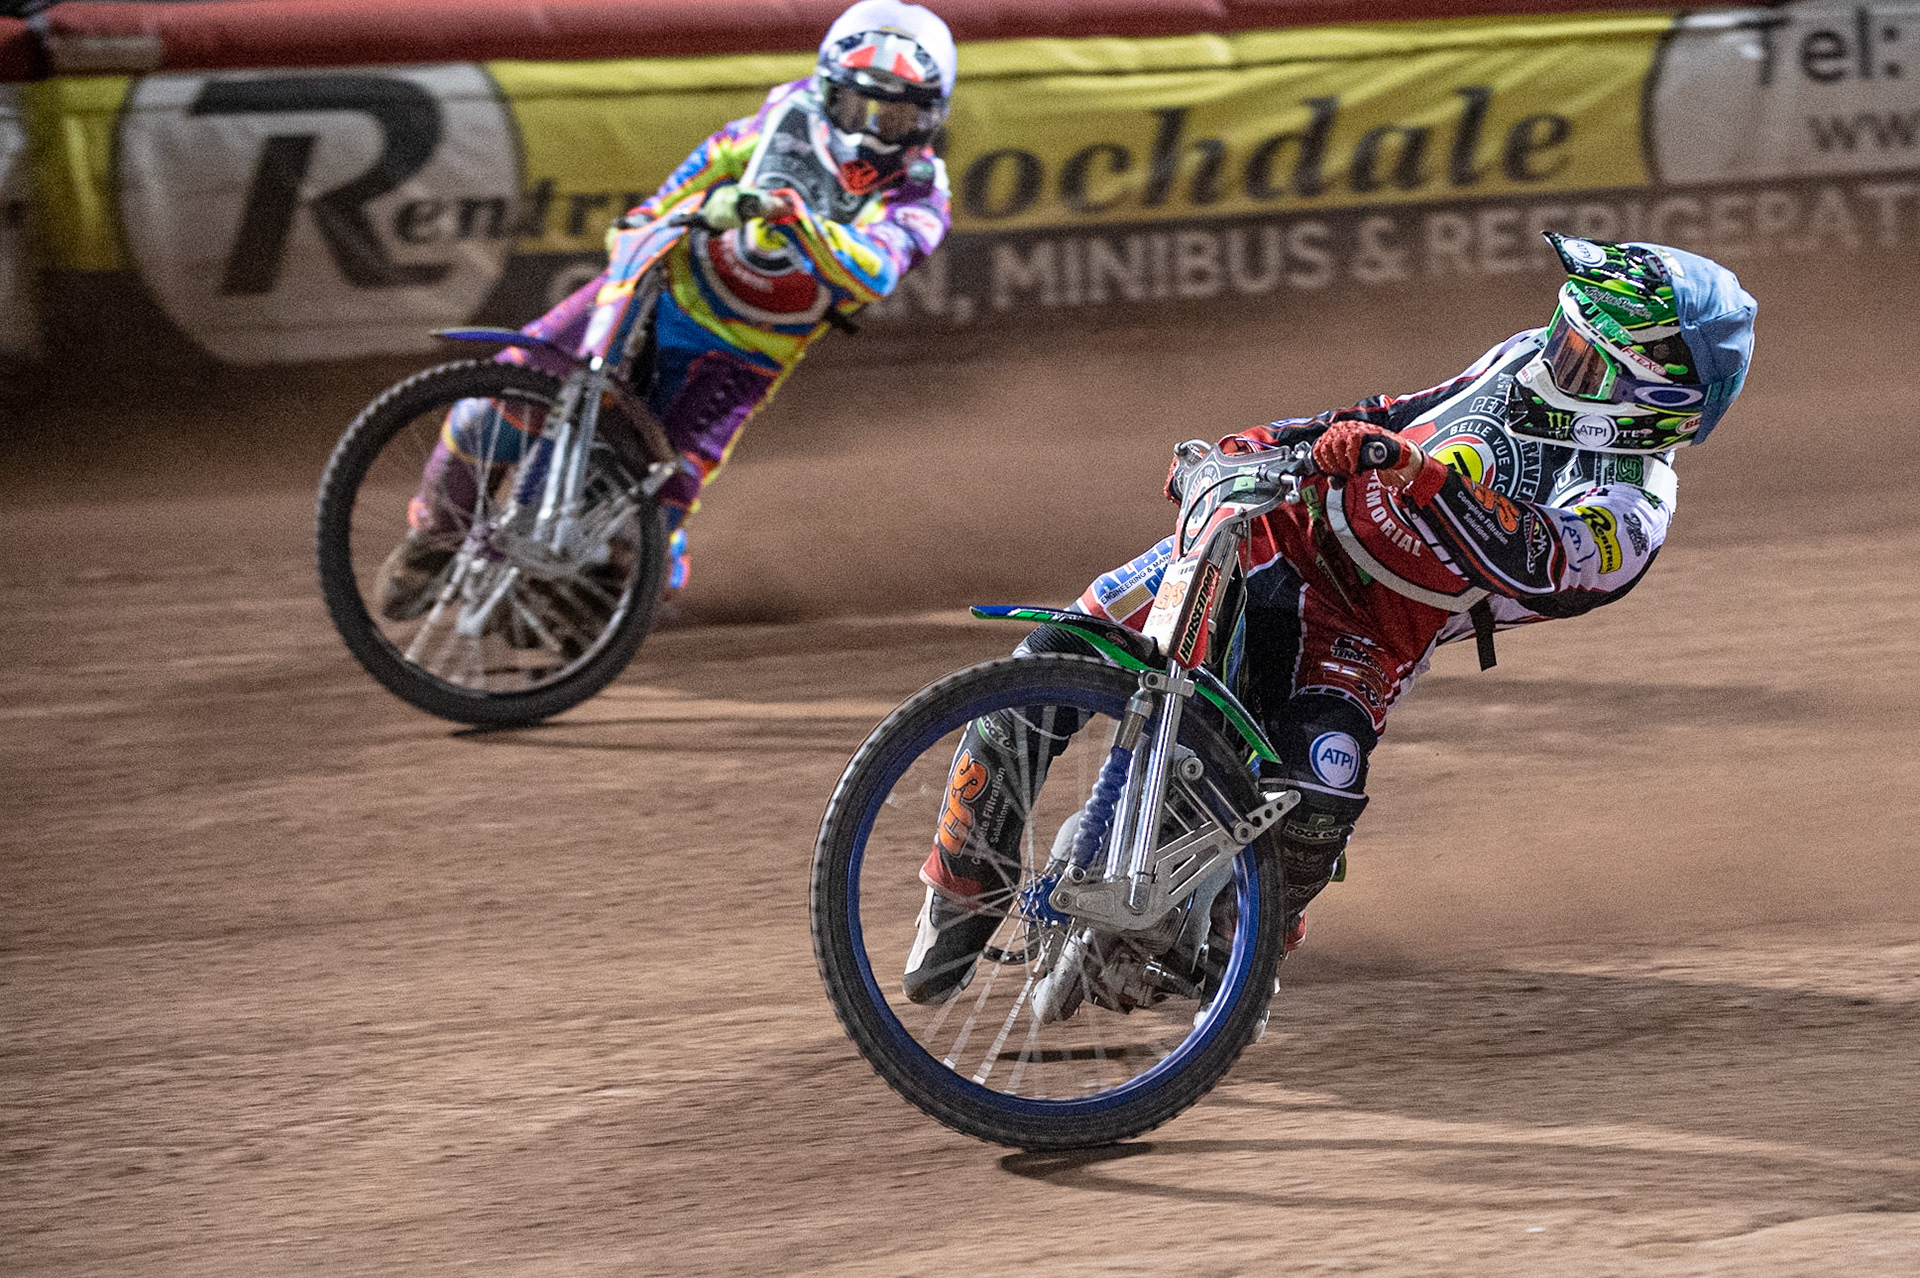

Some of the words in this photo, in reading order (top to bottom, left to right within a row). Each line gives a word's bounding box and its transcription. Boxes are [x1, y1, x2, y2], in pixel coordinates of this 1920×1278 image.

[188, 74, 645, 297] Rentr
[960, 86, 1574, 221] ochdale
[996, 221, 1335, 311] MINIBUS
[1350, 216, 1412, 284] &
[1449, 421, 1493, 437] BELLE
[1492, 436, 1511, 467] VUE
[1577, 424, 1607, 437] ATPI
[1456, 490, 1486, 521] Complete
[1483, 518, 1509, 546] Filtration
[1462, 512, 1491, 541] Solutions
[1100, 571, 1147, 605] ENGINEERING
[1146, 566, 1153, 574] &
[1320, 747, 1354, 770] ATPI
[982, 766, 1007, 821] Filtration
